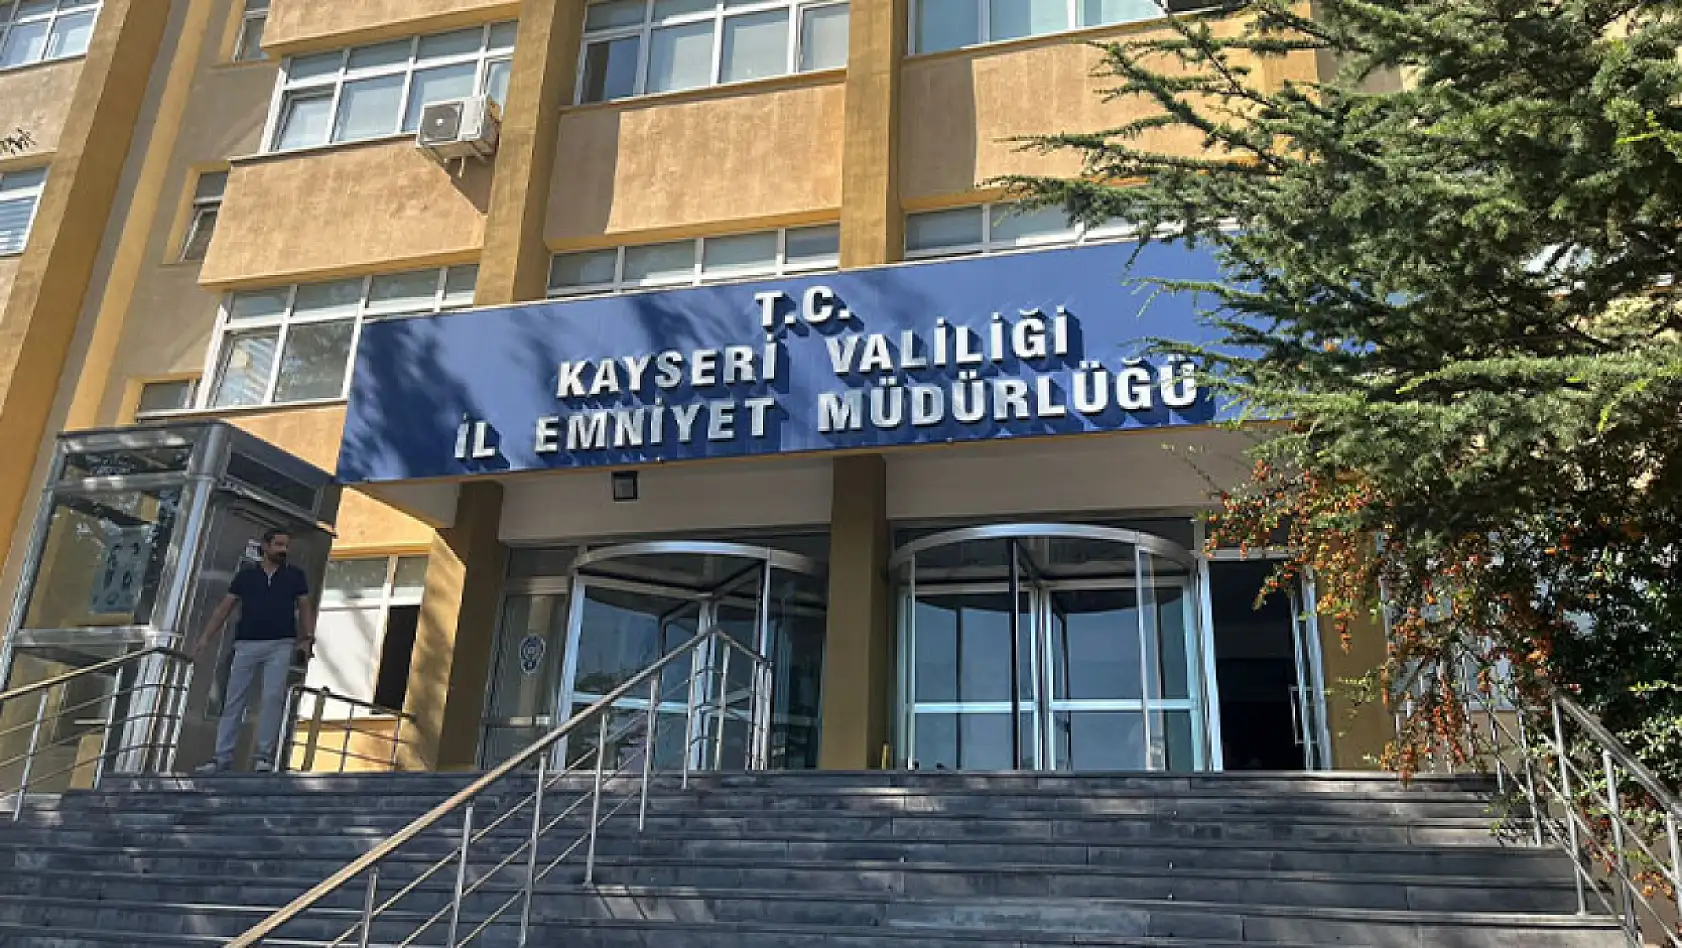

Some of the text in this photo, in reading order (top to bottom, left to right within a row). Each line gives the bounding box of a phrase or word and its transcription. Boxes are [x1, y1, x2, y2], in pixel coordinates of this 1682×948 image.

[556, 305, 1069, 397] KAYSERİ VALİLİĞİ
[755, 285, 852, 327] T.C.
[454, 354, 1198, 458] İL EMNİYET MÜDÜRLÜĞÜ
